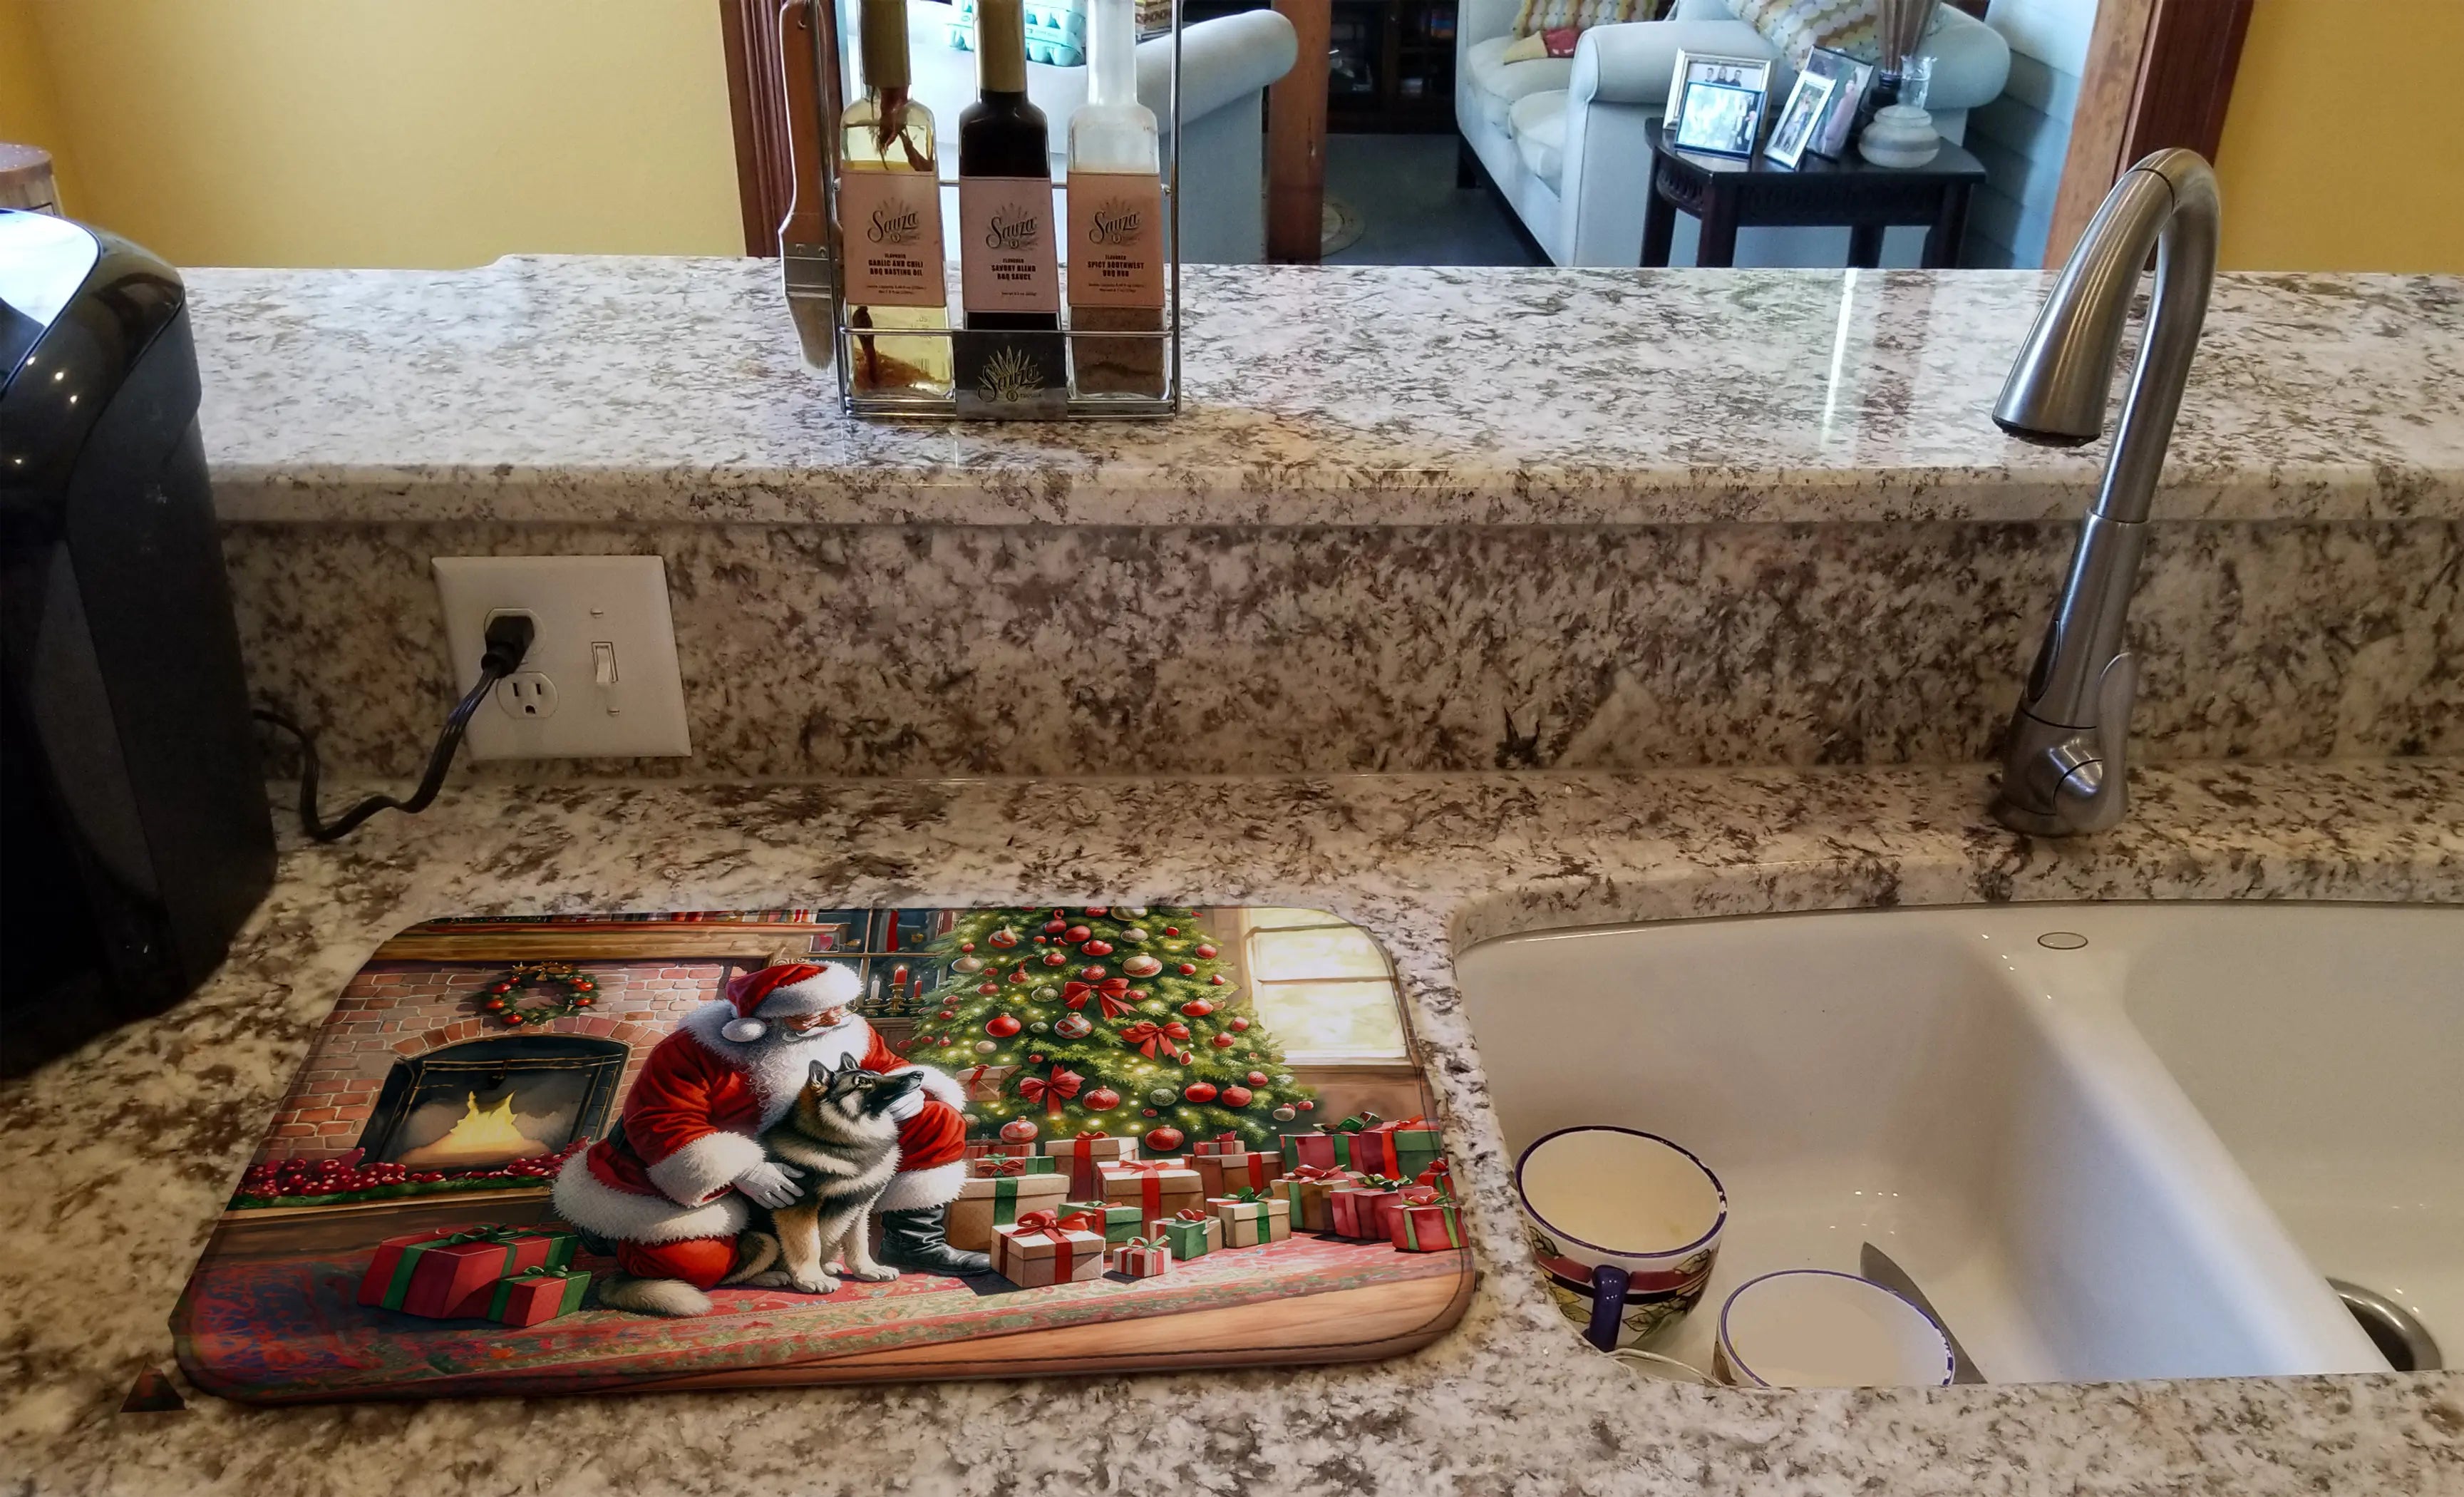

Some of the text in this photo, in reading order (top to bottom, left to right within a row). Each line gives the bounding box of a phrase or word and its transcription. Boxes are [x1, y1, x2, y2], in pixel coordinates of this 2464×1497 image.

[867, 210, 919, 243] Sauza
[986, 217, 1037, 249] Sauza
[1089, 212, 1140, 244] Sauza
[977, 364, 1039, 403] Sauza
